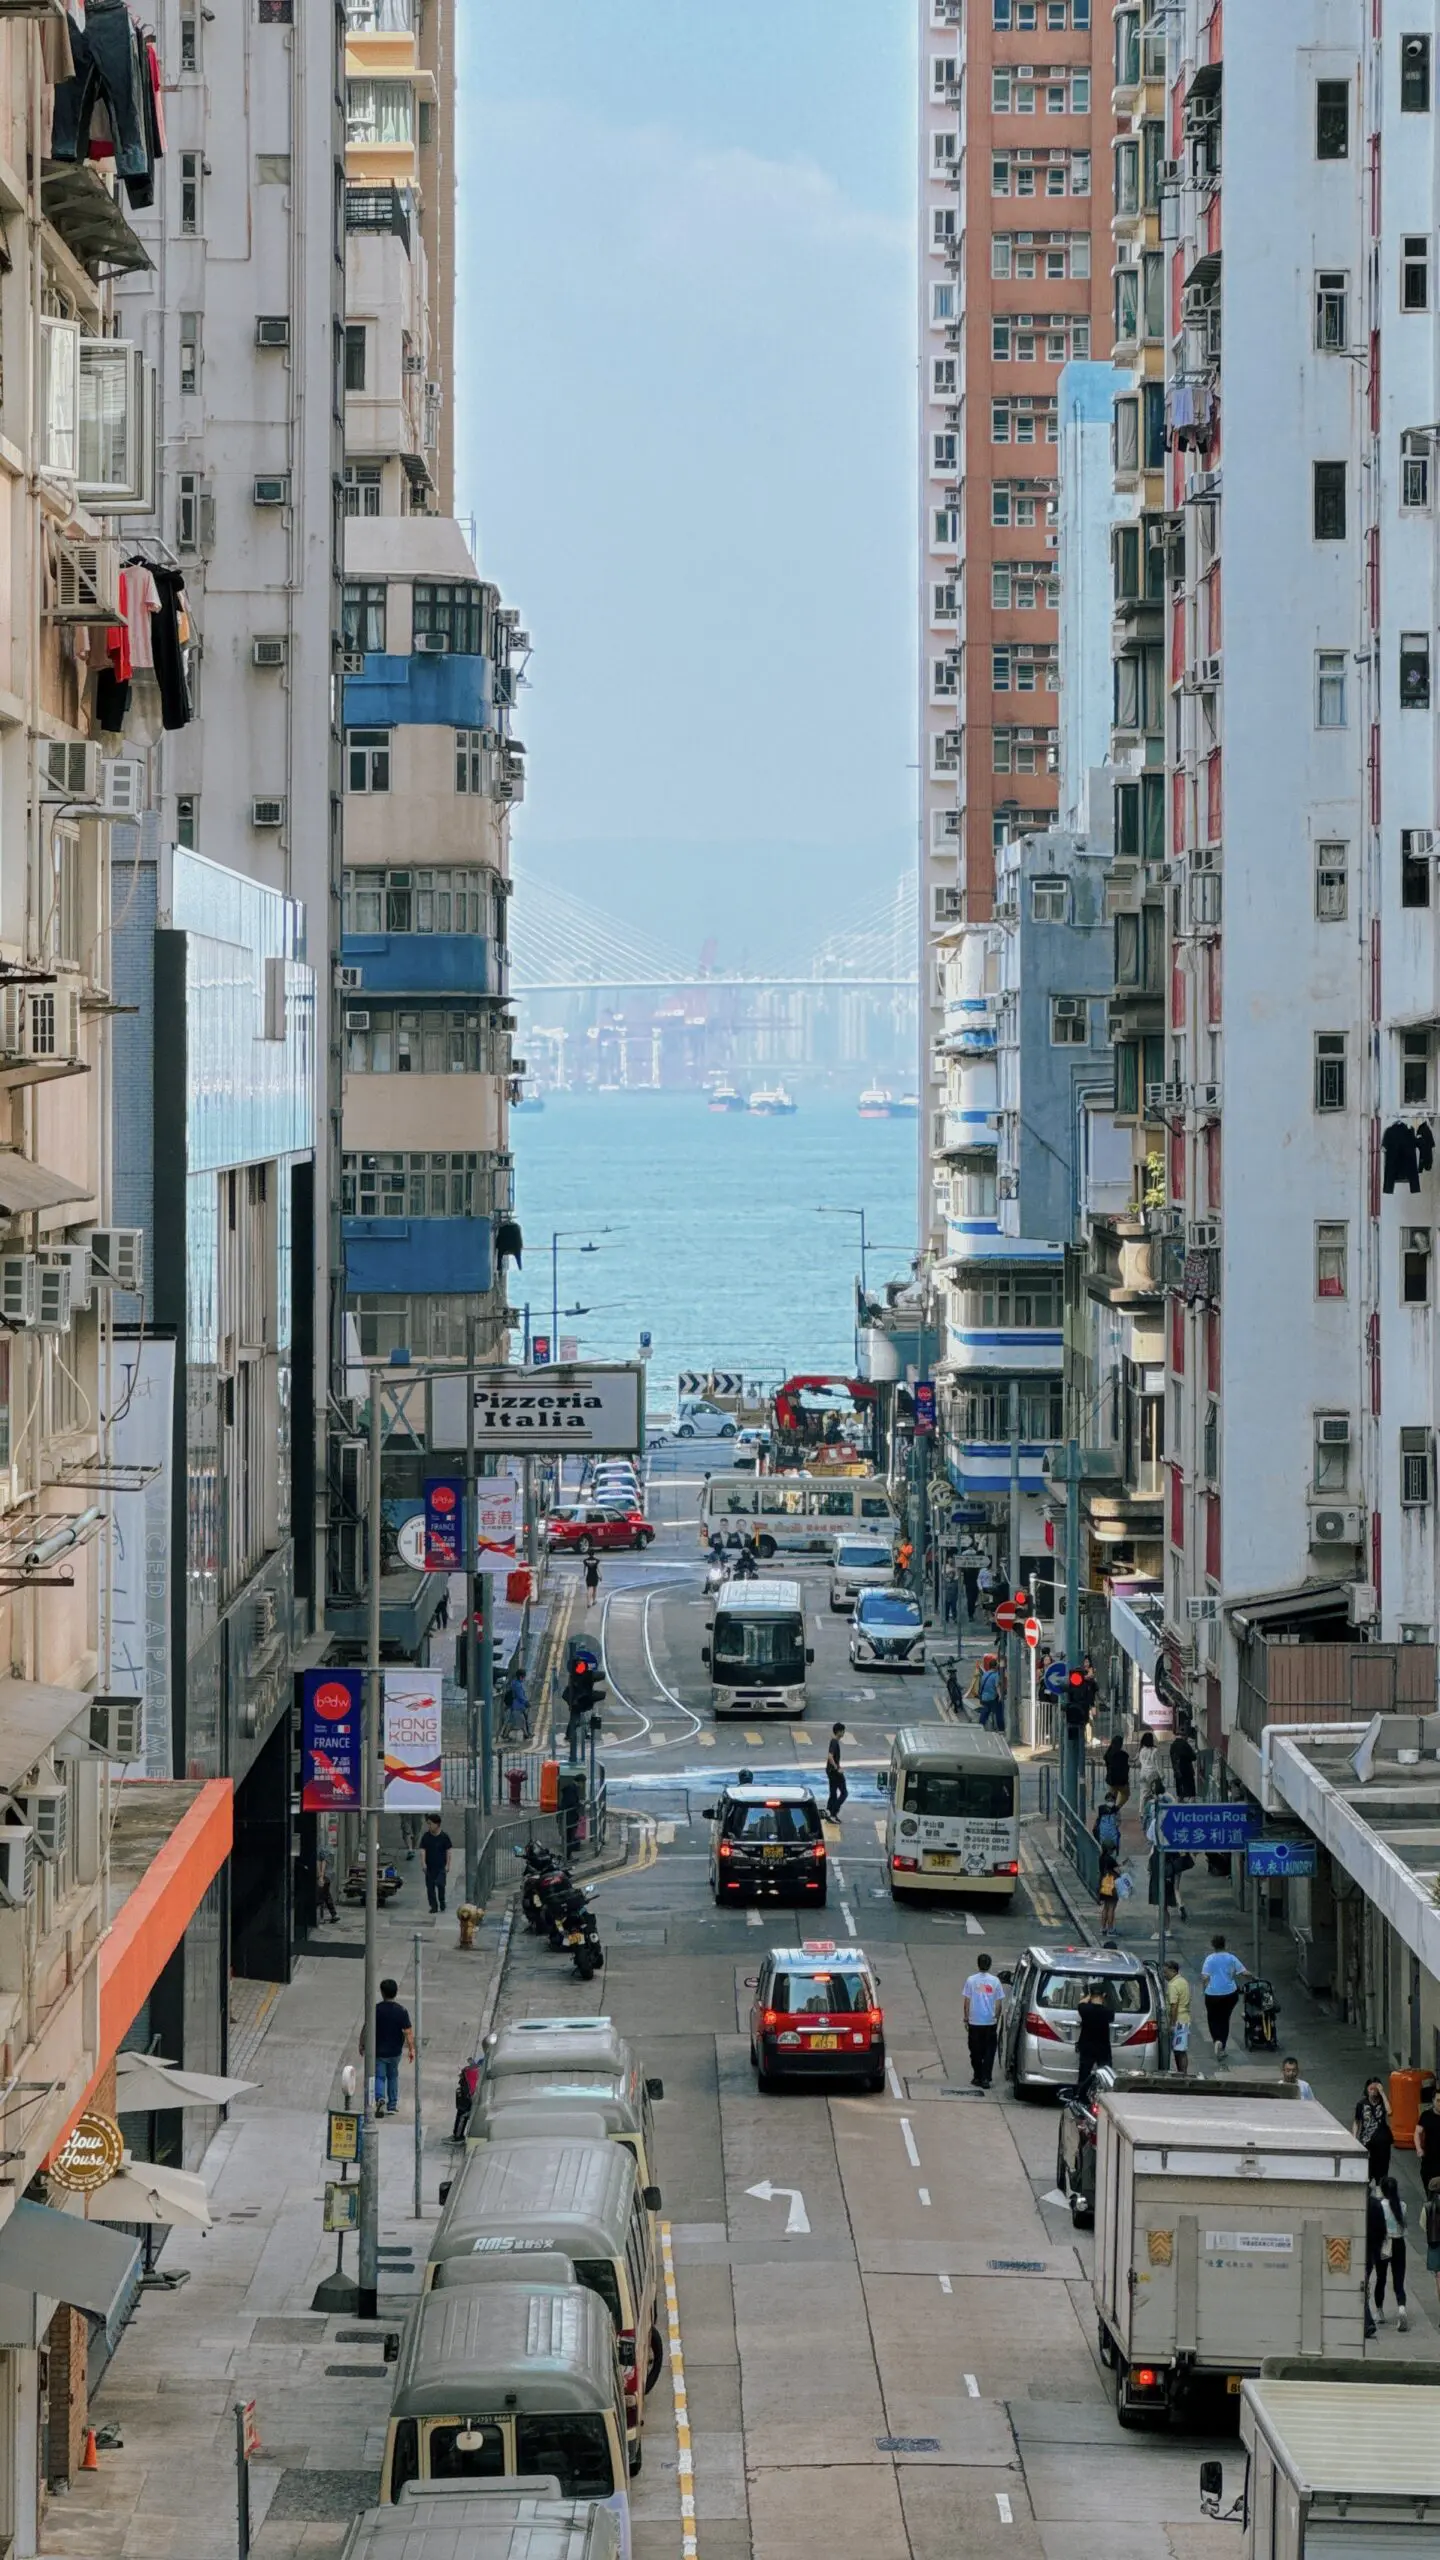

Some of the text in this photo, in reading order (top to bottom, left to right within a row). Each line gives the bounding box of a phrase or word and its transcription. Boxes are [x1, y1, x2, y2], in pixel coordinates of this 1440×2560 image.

[473, 1392, 602, 1409] Pizzeria
[484, 1411, 586, 1427] Italia
[430, 1523, 456, 1531] FRANCE
[389, 1718, 438, 1730] HONG
[313, 1737, 351, 1749] FRANCE
[389, 1731, 438, 1743] KONG
[1172, 1811, 1221, 1823] Victoria
[1172, 1827, 1244, 1845] 域多利道
[1251, 1860, 1313, 1875] 洗衣 LAUNDRY
[58, 2148, 105, 2169] House
